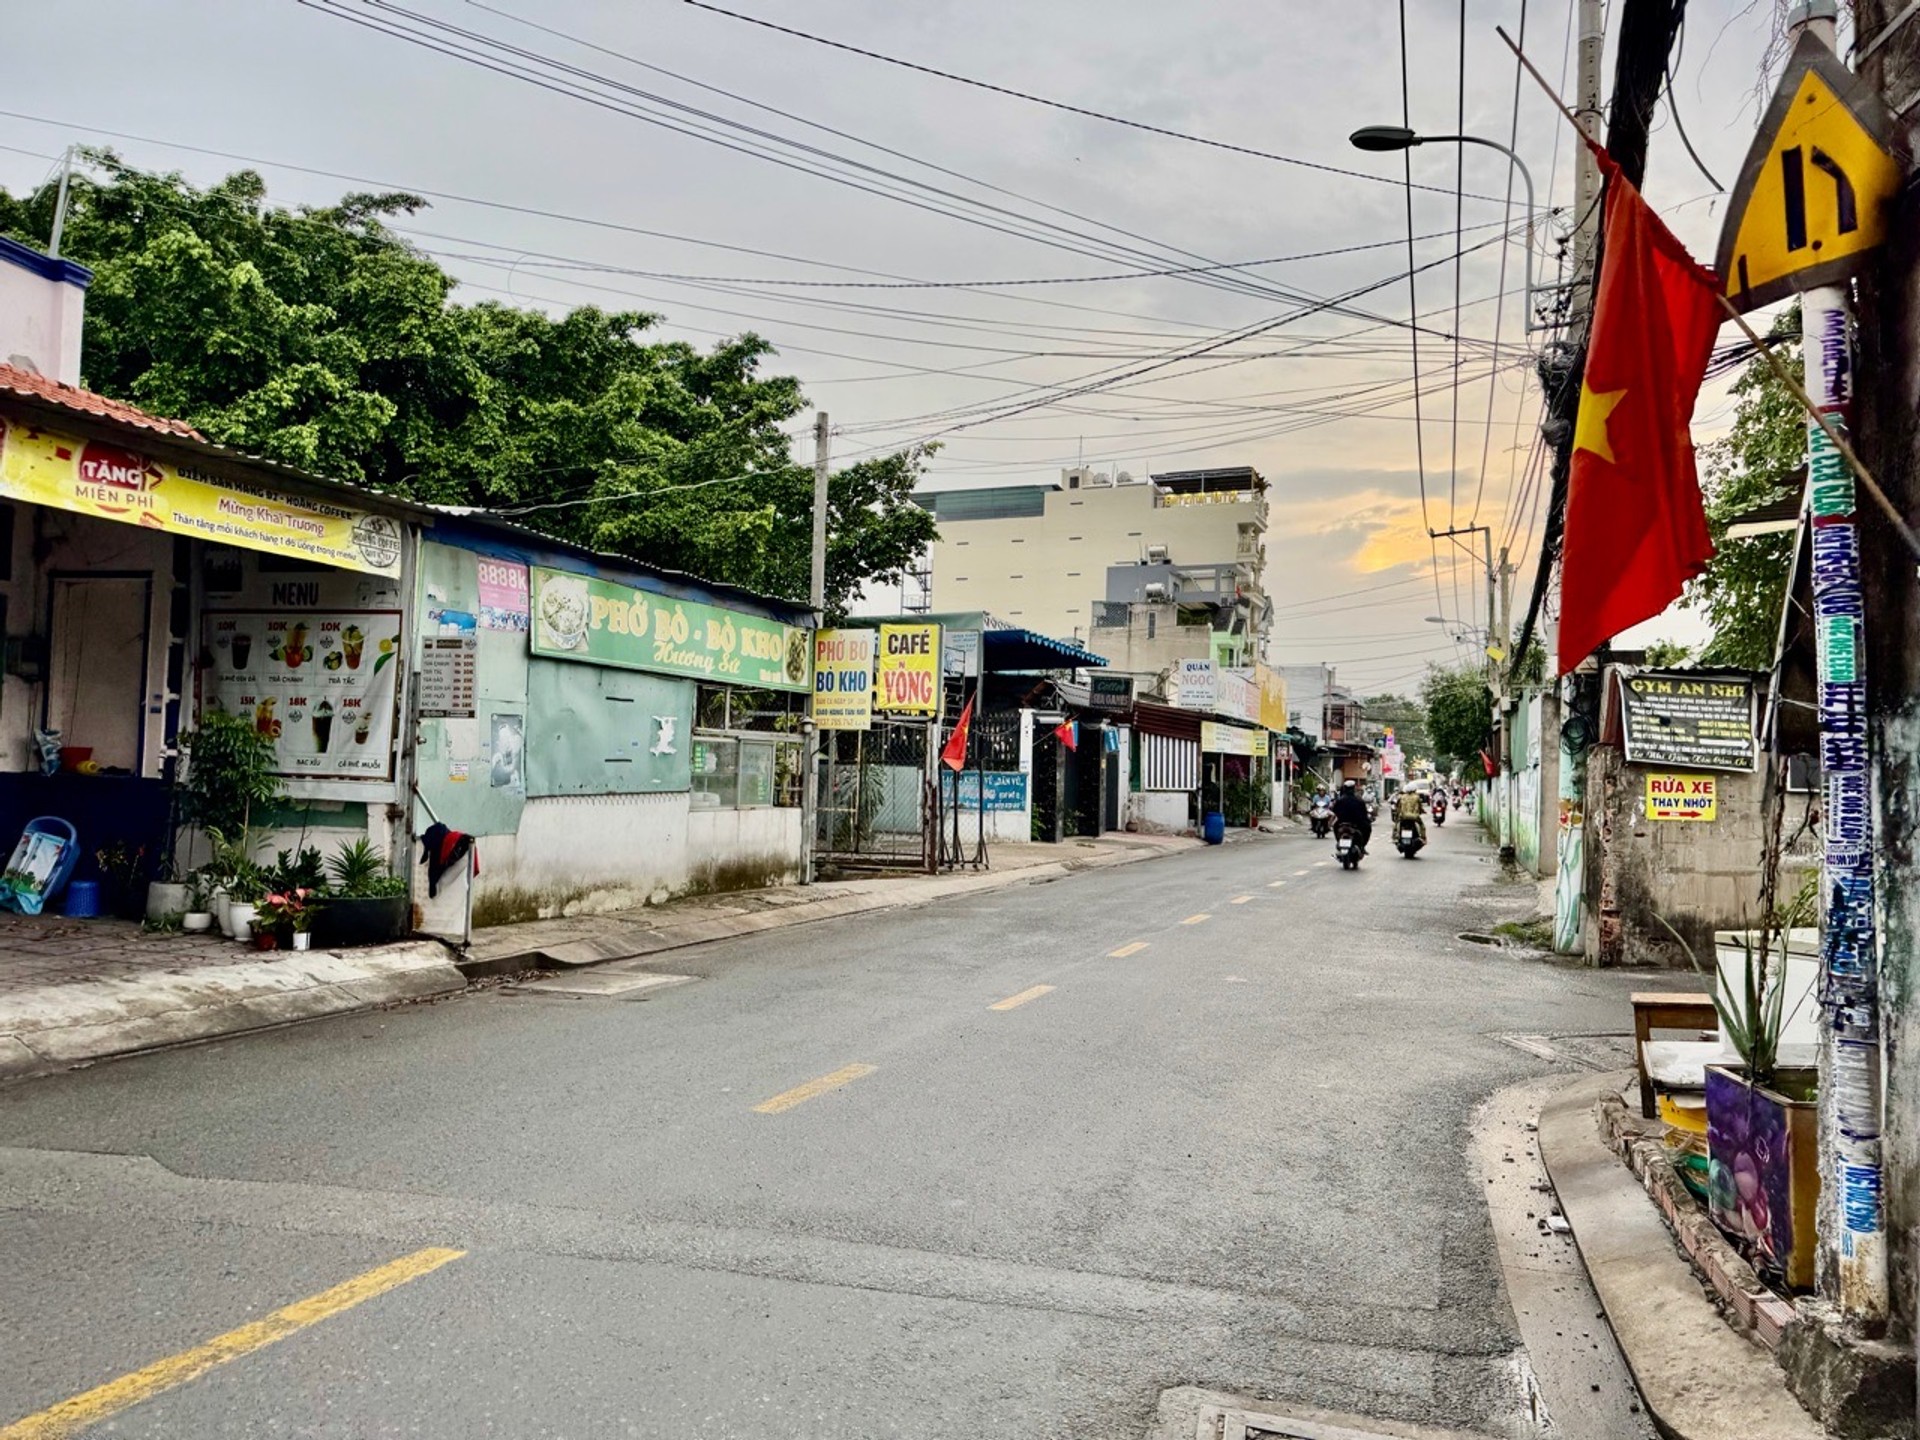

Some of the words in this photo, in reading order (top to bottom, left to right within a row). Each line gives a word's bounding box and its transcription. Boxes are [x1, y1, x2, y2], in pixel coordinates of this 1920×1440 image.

[83, 459, 141, 485] TẶNG
[126, 493, 153, 509] PHÍ
[218, 496, 255, 522] Mừng
[256, 505, 284, 525] Khai
[319, 503, 353, 520] COFFEE
[316, 543, 335, 558] trong
[336, 550, 357, 561] menu
[478, 563, 527, 591] 8888k
[272, 582, 320, 606] MENU
[267, 621, 288, 632] 10K
[320, 622, 341, 632] 10K
[590, 592, 649, 637] PHỞ
[654, 604, 690, 645] BÒ
[706, 615, 737, 655] BÒ
[741, 626, 783, 662] KHO
[817, 633, 846, 662] PHỞ
[849, 634, 869, 661] BÒ
[888, 629, 930, 655] CAFÉ
[1185, 660, 1211, 672] QUÁN
[816, 665, 835, 693] BÒ
[838, 670, 868, 693] KHO
[1631, 679, 1673, 694] GYM
[1677, 681, 1705, 696] AN
[1711, 683, 1745, 698] NHI
[289, 697, 308, 707] 18K
[343, 698, 362, 708] 18K
[1651, 775, 1686, 794] RỬA
[1692, 781, 1714, 794] XE
[1652, 797, 1680, 808] THAY
